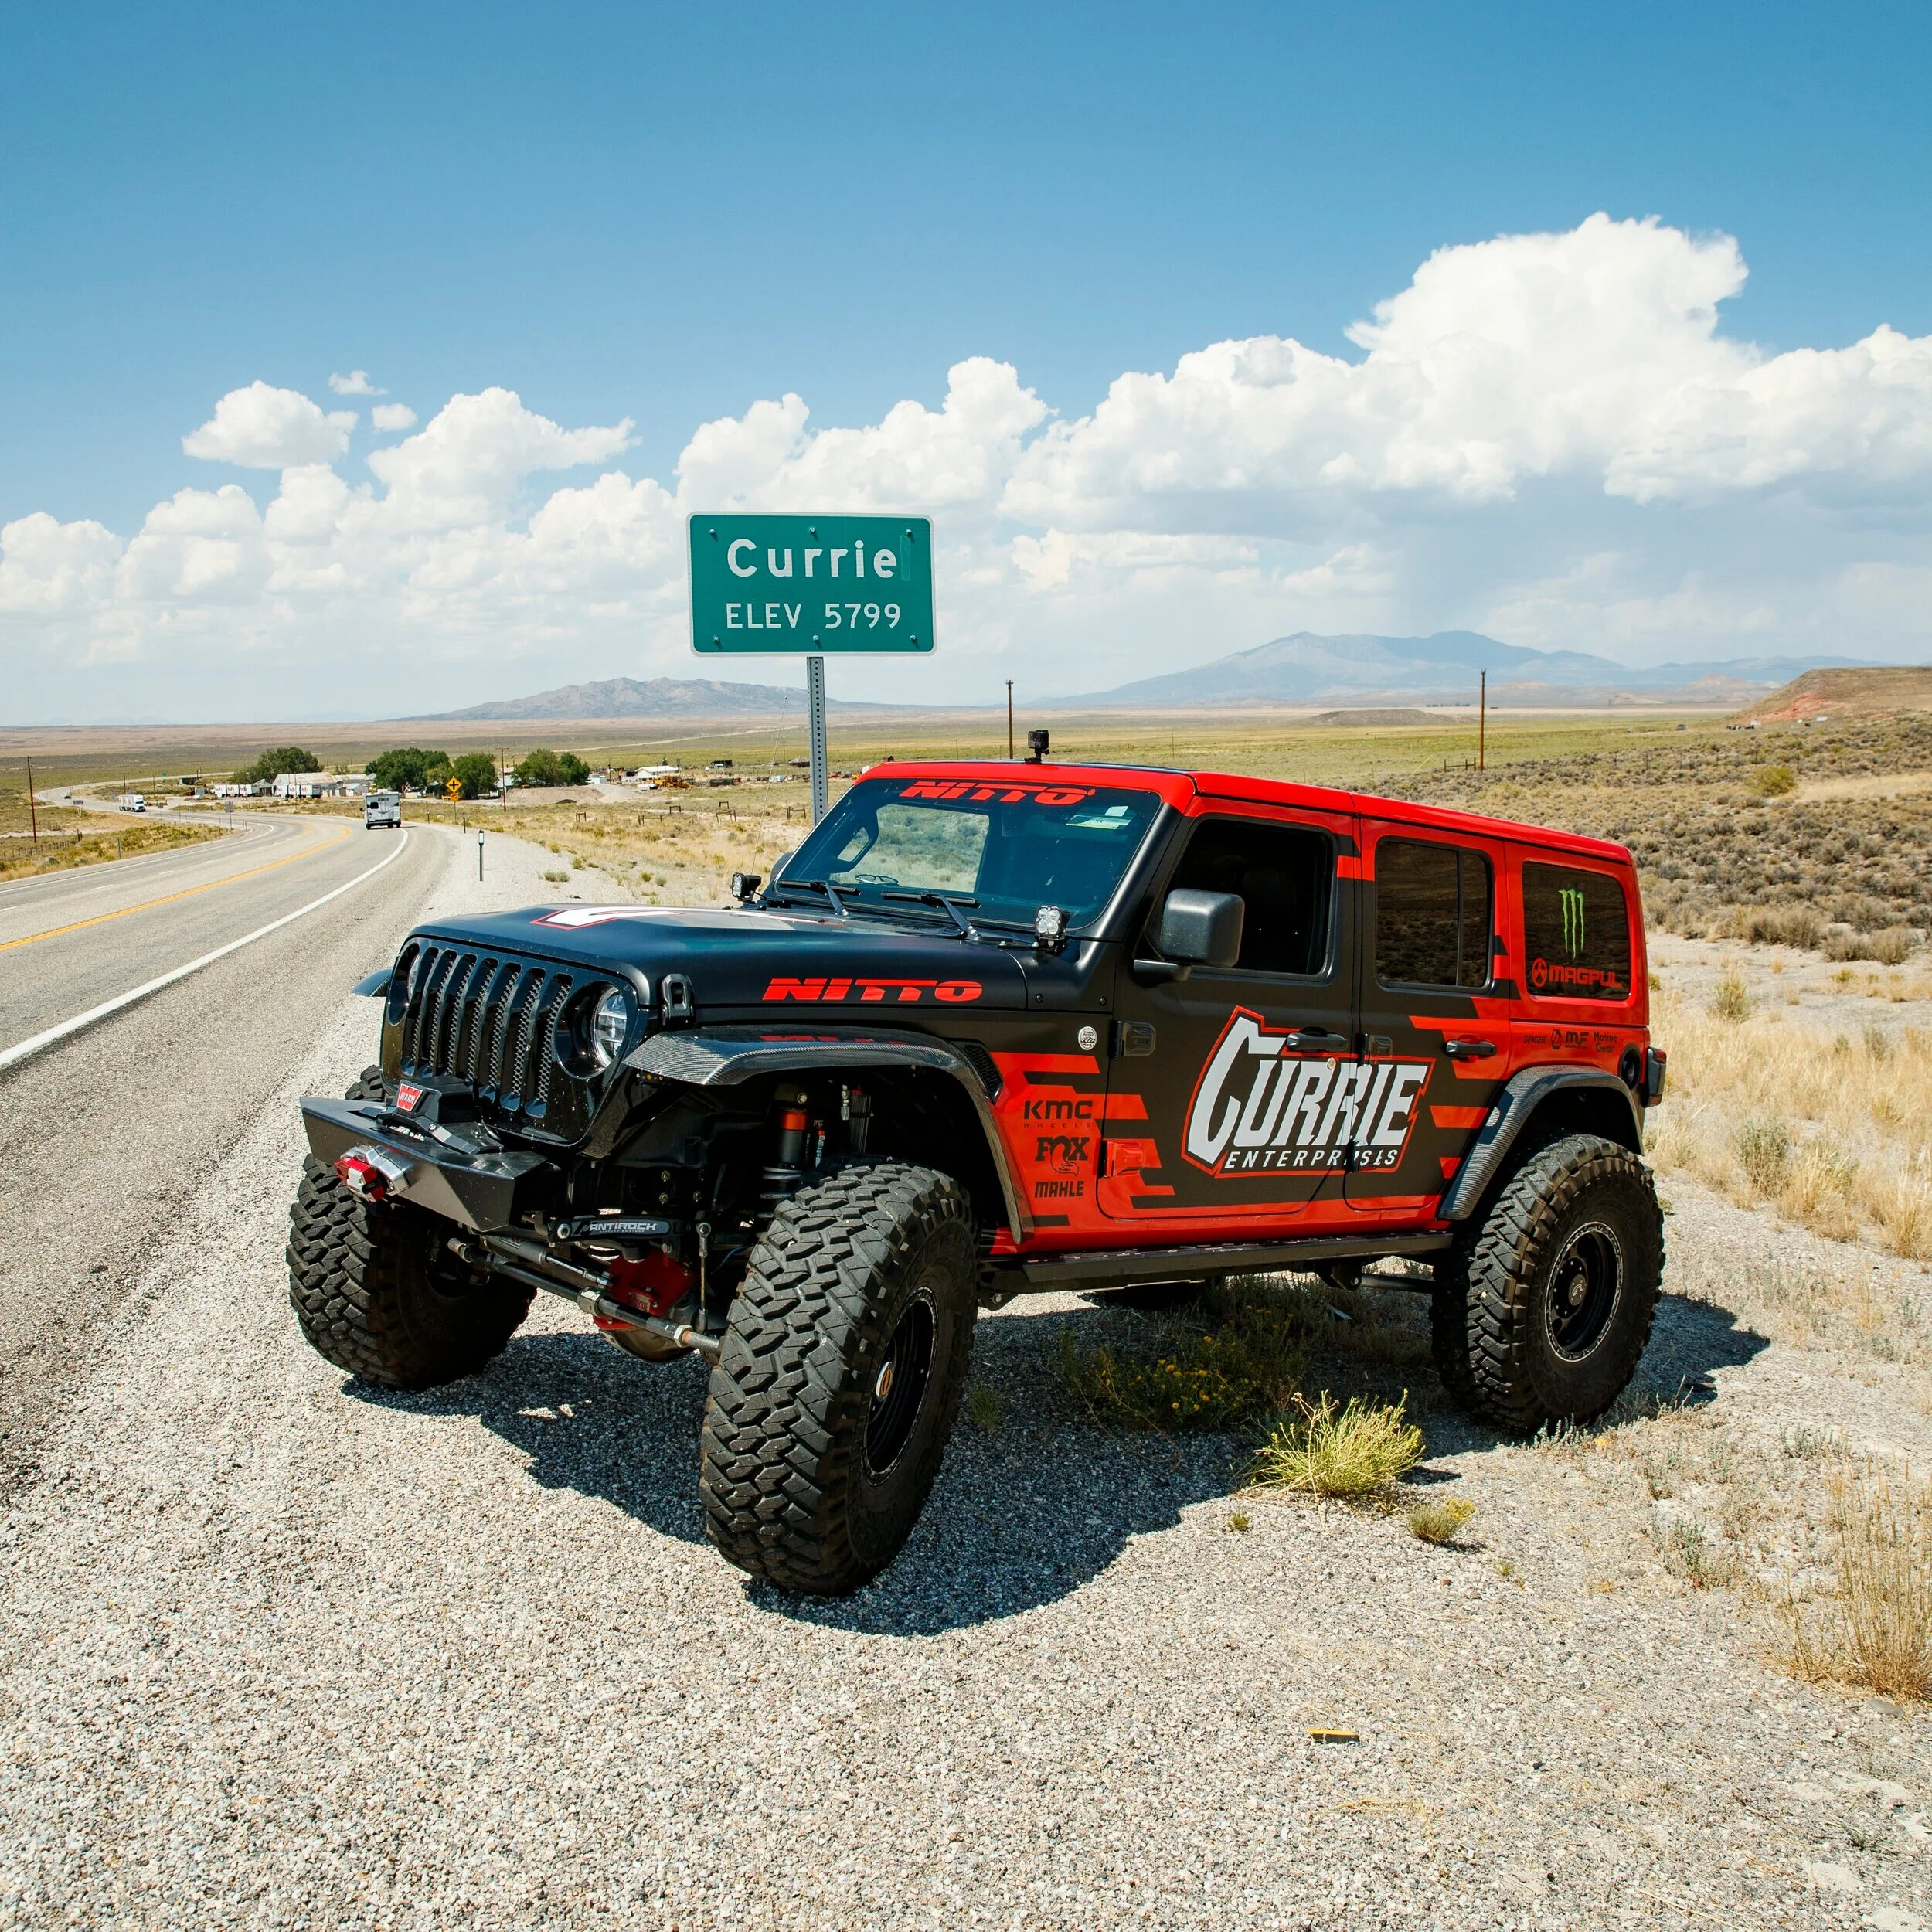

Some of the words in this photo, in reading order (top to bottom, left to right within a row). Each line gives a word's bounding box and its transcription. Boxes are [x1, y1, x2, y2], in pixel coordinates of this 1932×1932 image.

[727, 539, 897, 578] Currie
[726, 604, 801, 628] ELEV
[825, 603, 900, 628] 5799
[899, 781, 1087, 805] NITTO
[1549, 964, 1622, 988] MAGPUL
[762, 978, 983, 1002] NITTO
[1593, 1031, 1617, 1043] Motive
[400, 1092, 416, 1104] WARN
[1188, 1016, 1428, 1164] CURRIE
[1035, 1135, 1090, 1162] FOX
[1034, 1181, 1084, 1198] MAHLE
